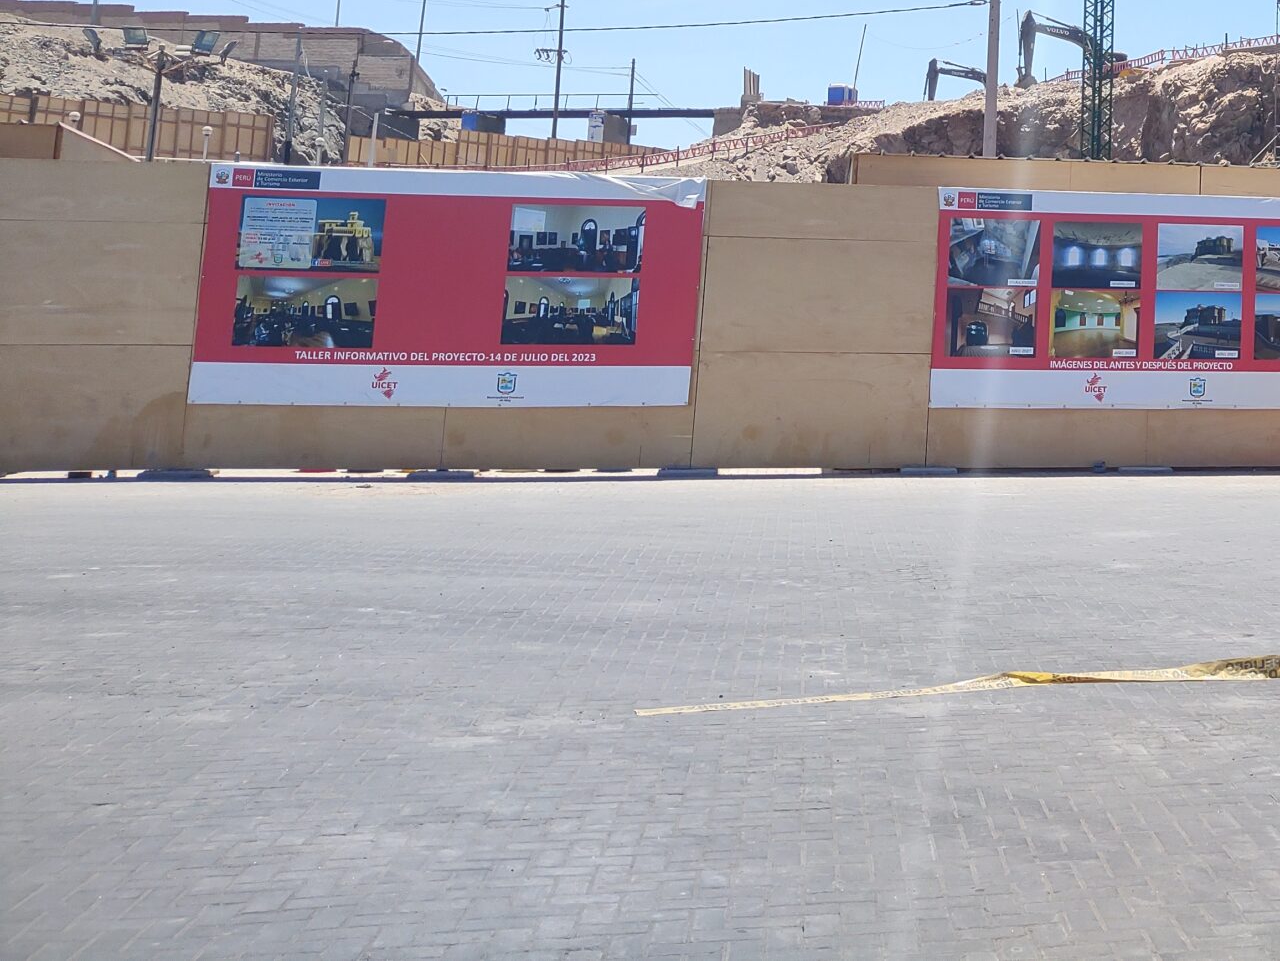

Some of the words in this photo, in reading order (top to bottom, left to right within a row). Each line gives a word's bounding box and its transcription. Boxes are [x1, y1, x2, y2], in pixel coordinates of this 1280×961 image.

[1046, 26, 1070, 36] VOLVO
[295, 351, 331, 360] TALLER
[334, 351, 408, 361] INFORMATIVO
[410, 352, 429, 361] DEL
[432, 352, 502, 362] PROYECTO-14
[504, 353, 517, 362] DE
[520, 353, 548, 362] JULIO
[551, 353, 570, 362] DEL
[571, 353, 596, 362] 2023
[1050, 359, 1093, 369] IMÁGENES
[1094, 360, 1109, 369] DEL
[1109, 360, 1135, 370] ANTES
[1135, 361, 1142, 370] Y
[1143, 360, 1177, 370] DESPUÉS
[1178, 362, 1192, 370] DEL
[1193, 362, 1233, 371] PROYECTO
[371, 381, 398, 389] UICET
